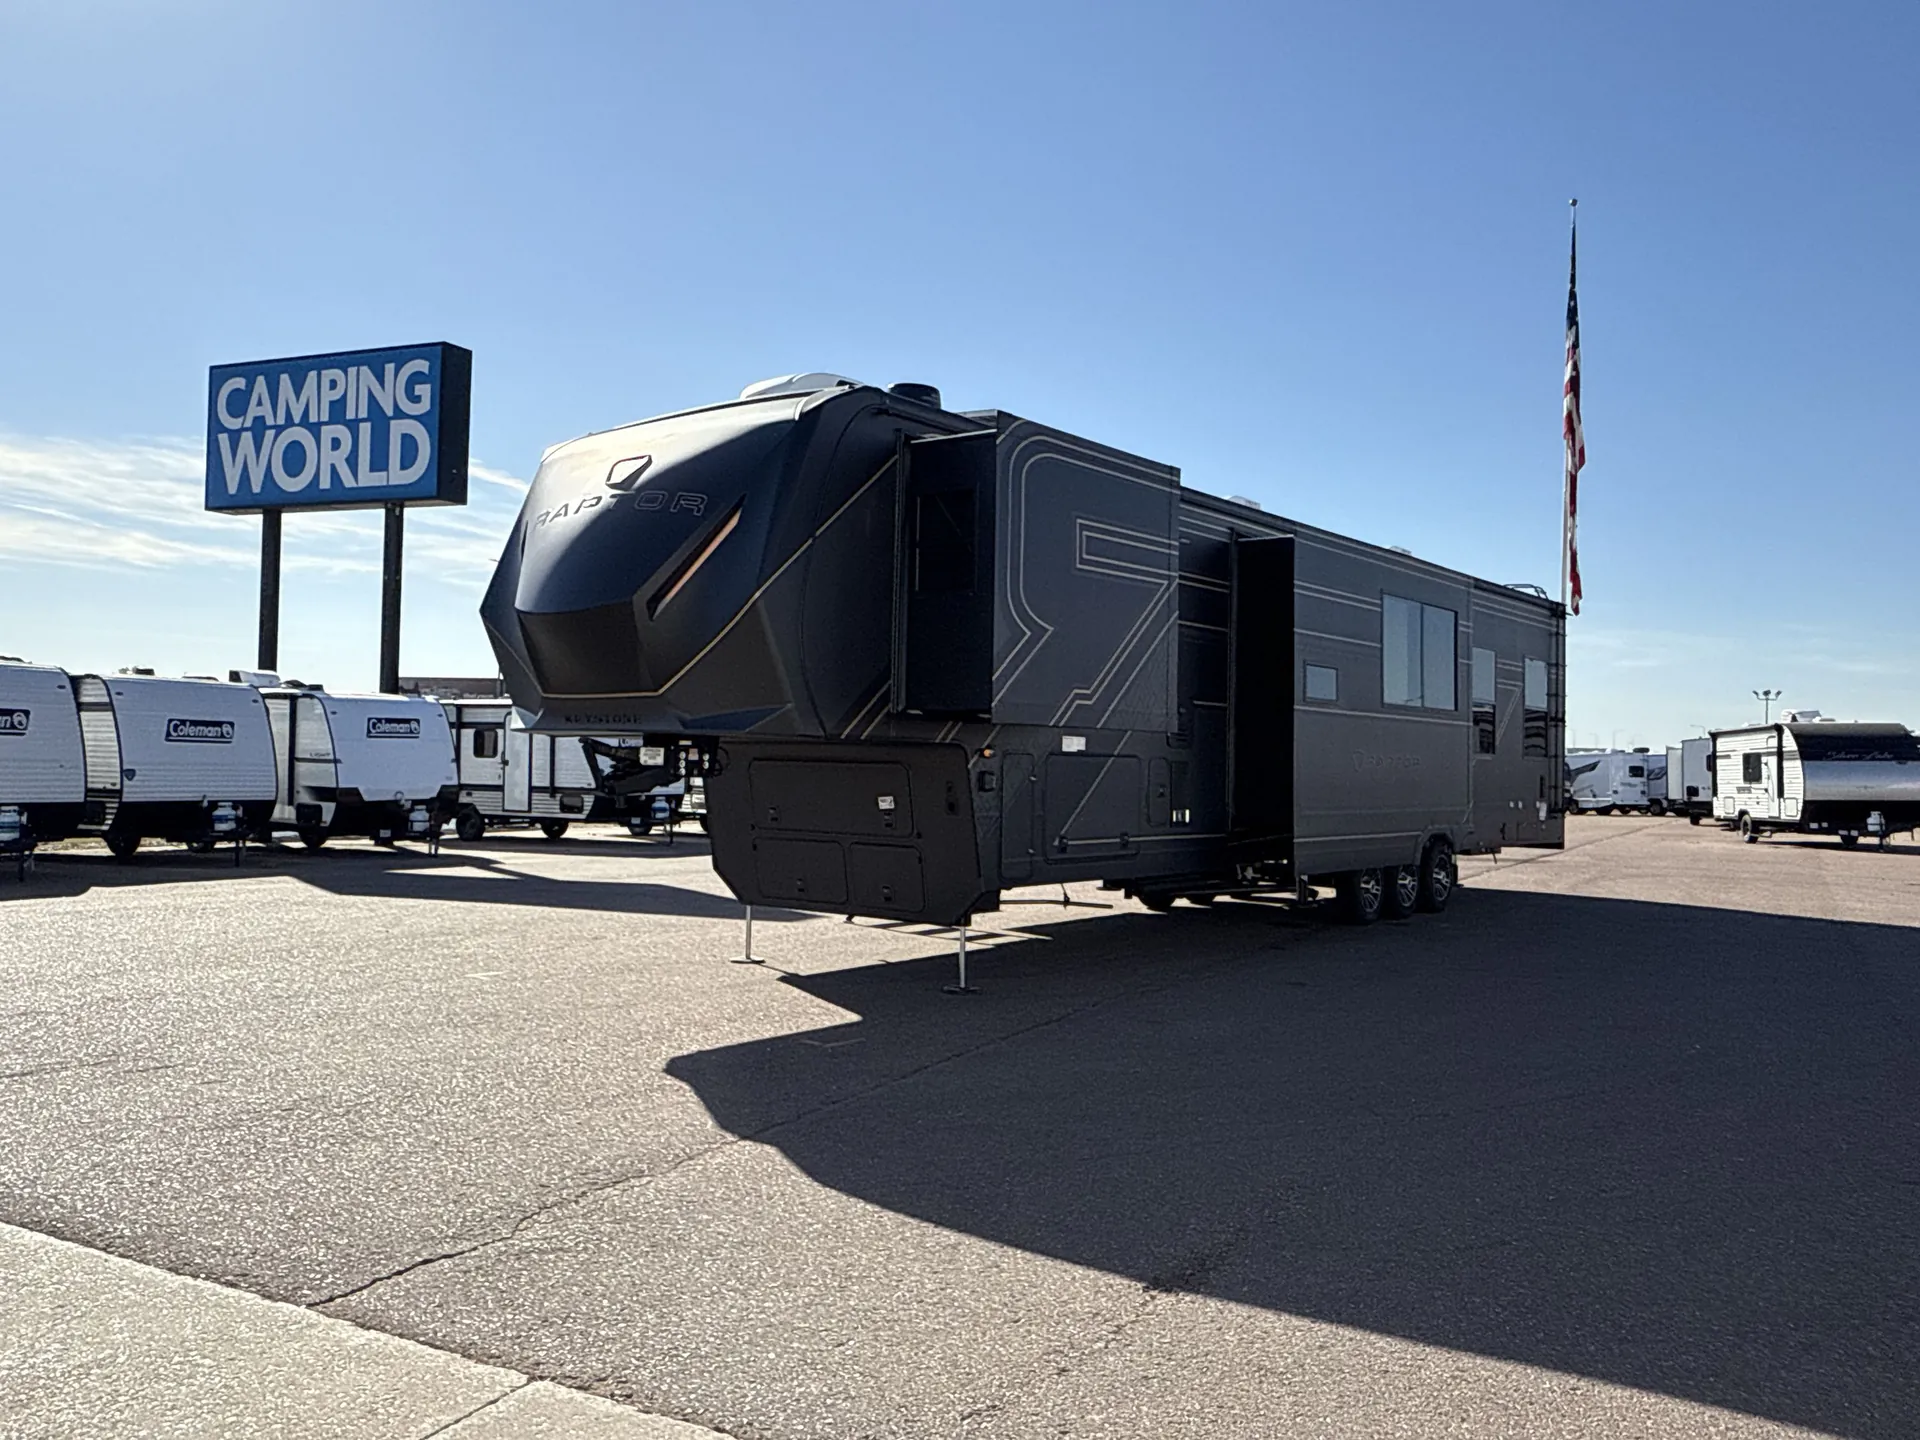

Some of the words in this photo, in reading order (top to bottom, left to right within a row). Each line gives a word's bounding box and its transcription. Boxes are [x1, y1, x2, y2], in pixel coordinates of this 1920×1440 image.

[216, 359, 432, 430] CAMPING
[217, 418, 432, 496] WORLD
[534, 490, 709, 528] RAPTOR
[169, 720, 222, 738] Coleman
[369, 718, 411, 733] Coleman
